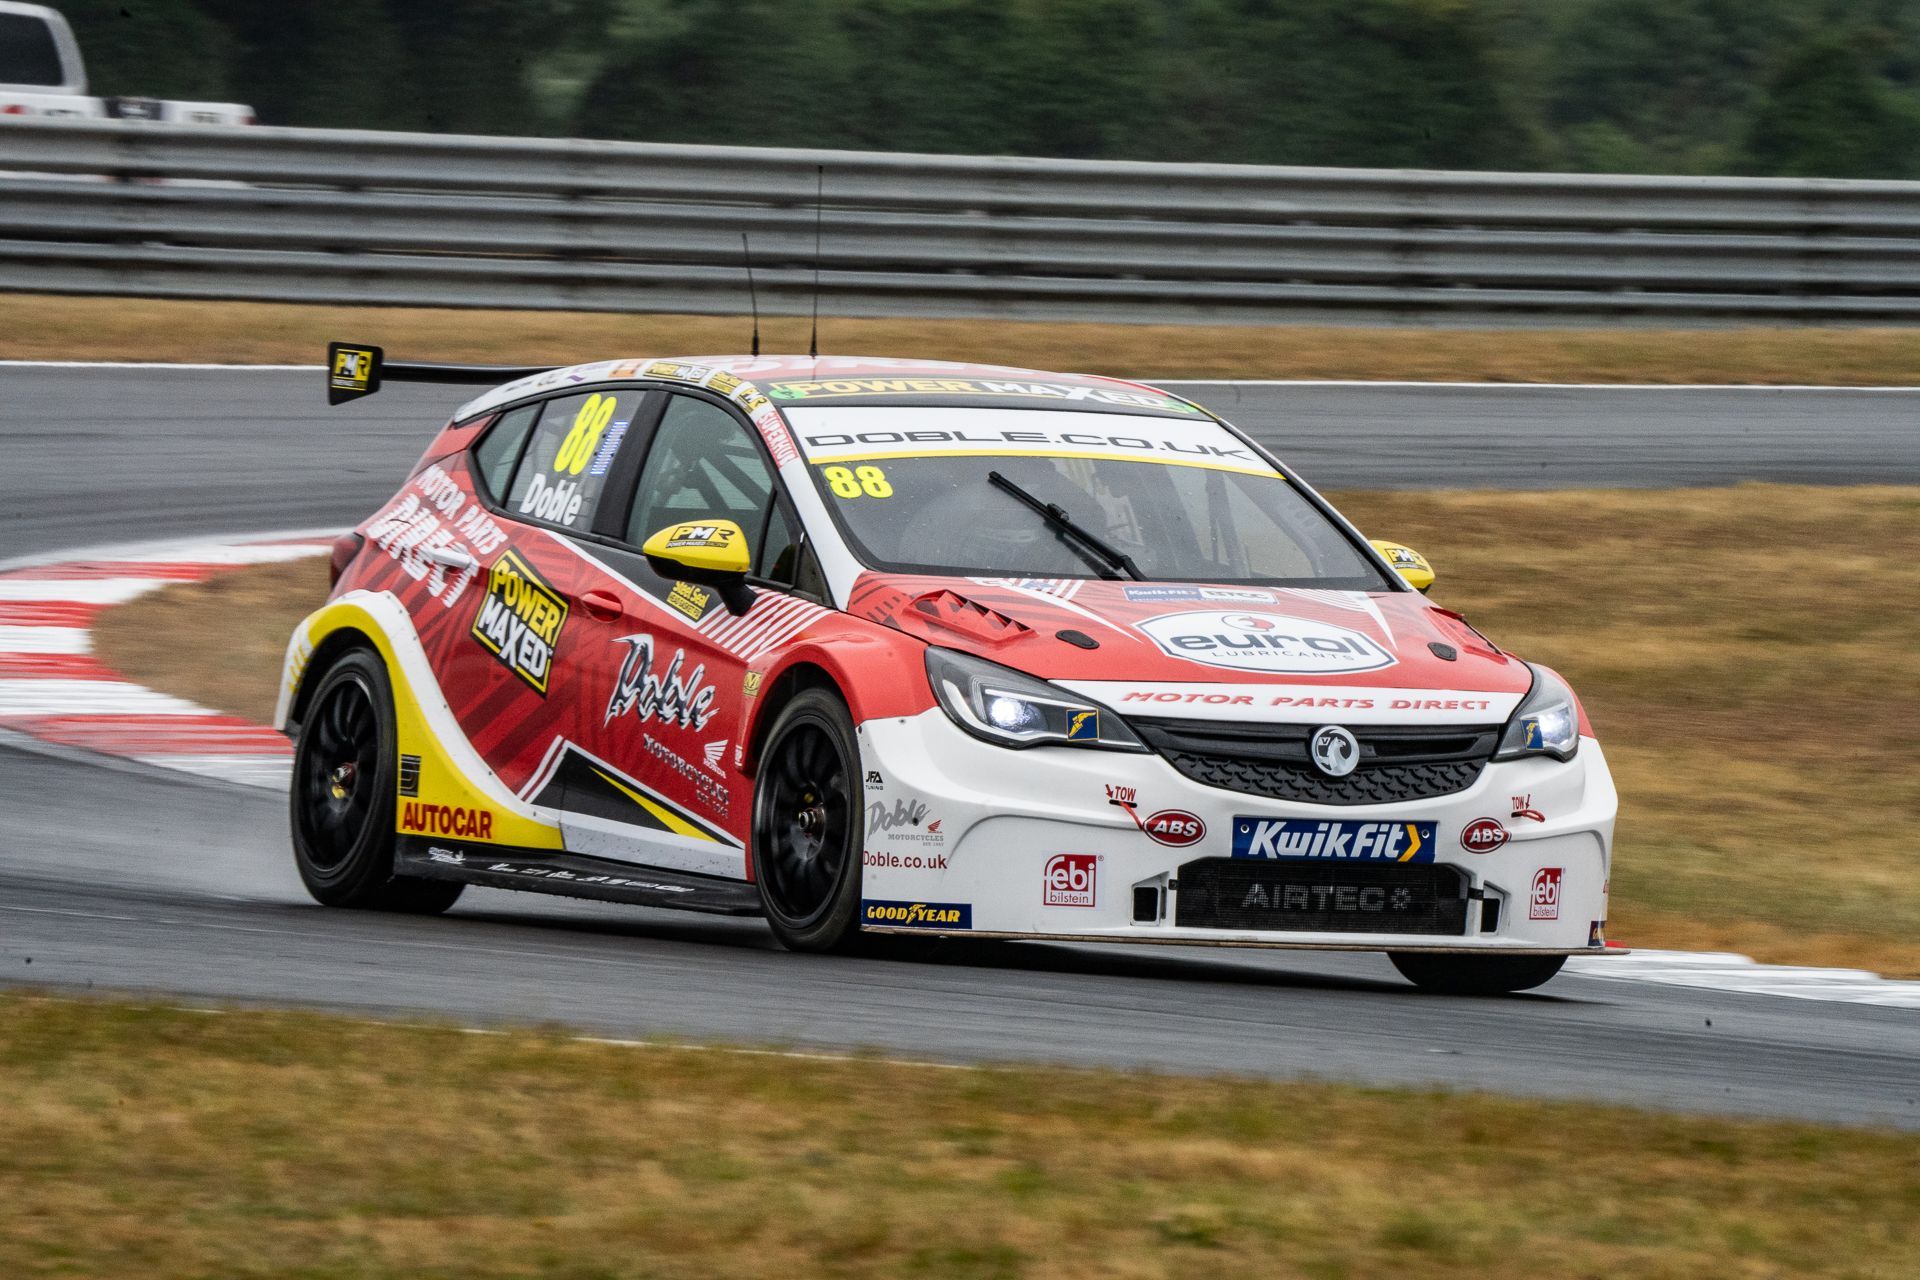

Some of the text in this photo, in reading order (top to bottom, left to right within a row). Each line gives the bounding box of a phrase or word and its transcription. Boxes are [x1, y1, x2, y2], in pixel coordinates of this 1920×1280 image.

[335, 353, 368, 377] PMR
[796, 379, 982, 396] POWER
[981, 382, 1167, 407] MAXED
[553, 393, 617, 475] 88
[805, 431, 1255, 461] DOBLE.CO.UK
[824, 466, 893, 499] 88
[416, 464, 509, 555] MOTOR PARTS
[519, 473, 582, 525] Doble
[670, 527, 735, 541] PMR
[492, 559, 561, 645] POWER
[478, 593, 548, 678] MAXED
[1170, 634, 1371, 656] eurol
[1212, 650, 1355, 661] LUBRICANTS
[604, 634, 720, 733] Doble
[1122, 692, 1490, 710] MOTOR PARTS DIRECT
[643, 733, 730, 805] MOTORCYCLES
[866, 771, 883, 783] JFA
[1115, 786, 1137, 801] TOW
[1512, 796, 1524, 810] TOW
[402, 802, 492, 839] AUTOCAR
[865, 799, 932, 842] Doble
[1153, 820, 1198, 837] ABS
[888, 834, 944, 842] MOTORCYCLES
[1469, 828, 1504, 844] ABS
[863, 850, 948, 869] Doble.co.uk
[1044, 856, 1096, 891] febi
[1050, 891, 1088, 904] bilstein
[1240, 883, 1385, 911] AIRTEC
[1531, 869, 1561, 905] febi
[1533, 906, 1556, 917] bilstein
